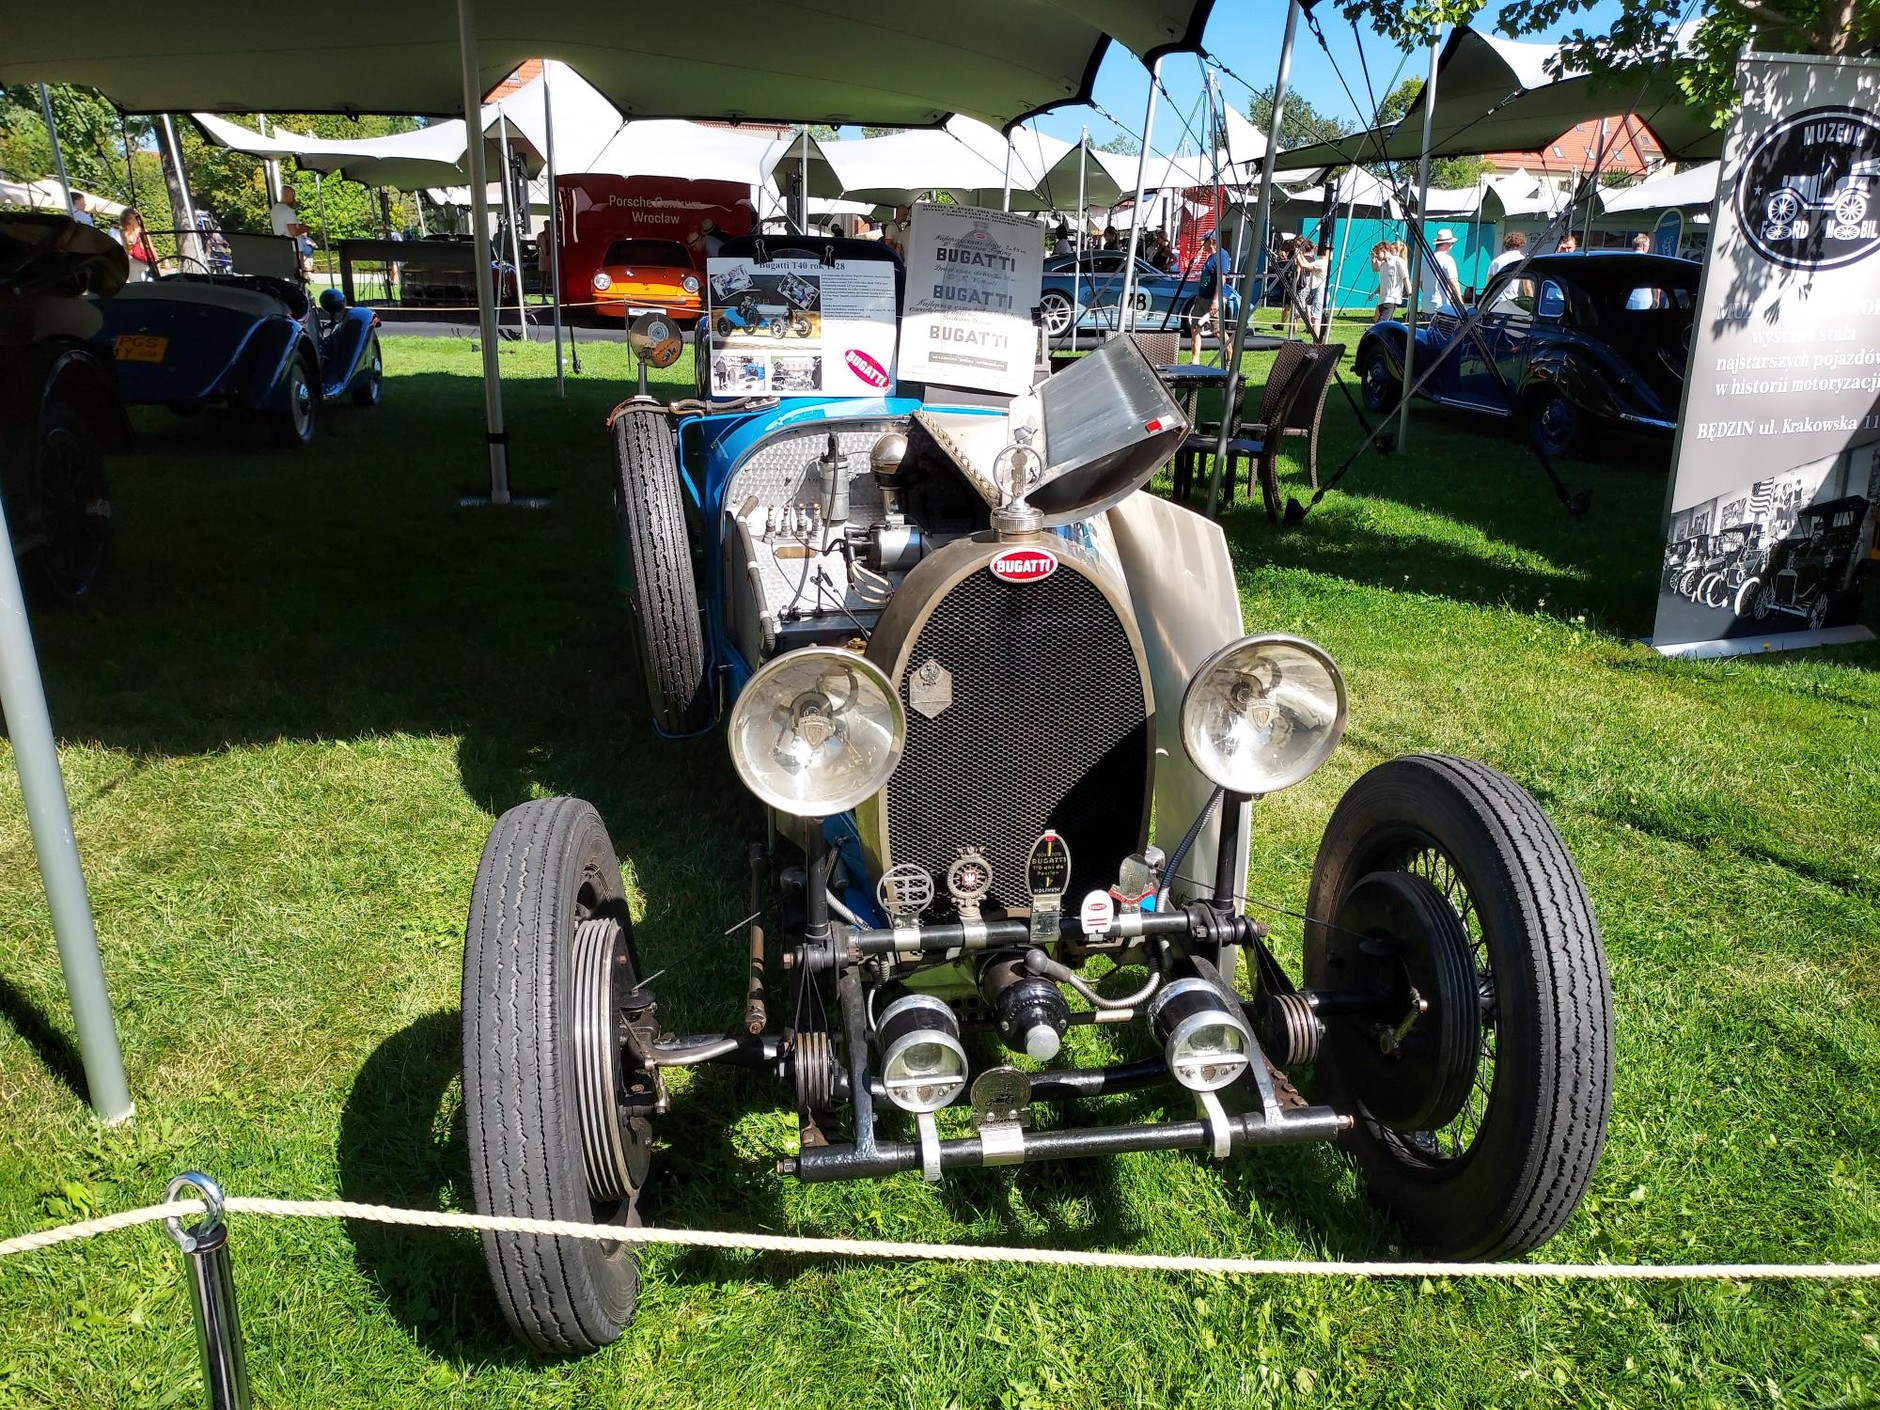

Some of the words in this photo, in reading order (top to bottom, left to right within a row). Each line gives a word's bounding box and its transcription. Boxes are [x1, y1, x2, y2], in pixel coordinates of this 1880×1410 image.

[1803, 122, 1867, 147] MUZEUM
[609, 194, 652, 208] Porsche
[632, 211, 680, 224] Wrocław
[792, 262, 808, 270] T40
[936, 247, 1016, 272] BUGATTI
[933, 284, 1013, 309] BUGATTI
[929, 325, 1008, 349] BUGATTI
[846, 350, 887, 387] BUGATTI
[1715, 350, 1810, 375] najstarszych
[1715, 383, 1729, 397] w
[1730, 376, 1789, 396] historii
[1696, 419, 1756, 442] BĘDZIN
[1758, 418, 1779, 436] ul.
[1781, 414, 1858, 435] Krakowska
[996, 558, 1052, 573] BUGATTI
[1031, 856, 1067, 865] BUGATTI
